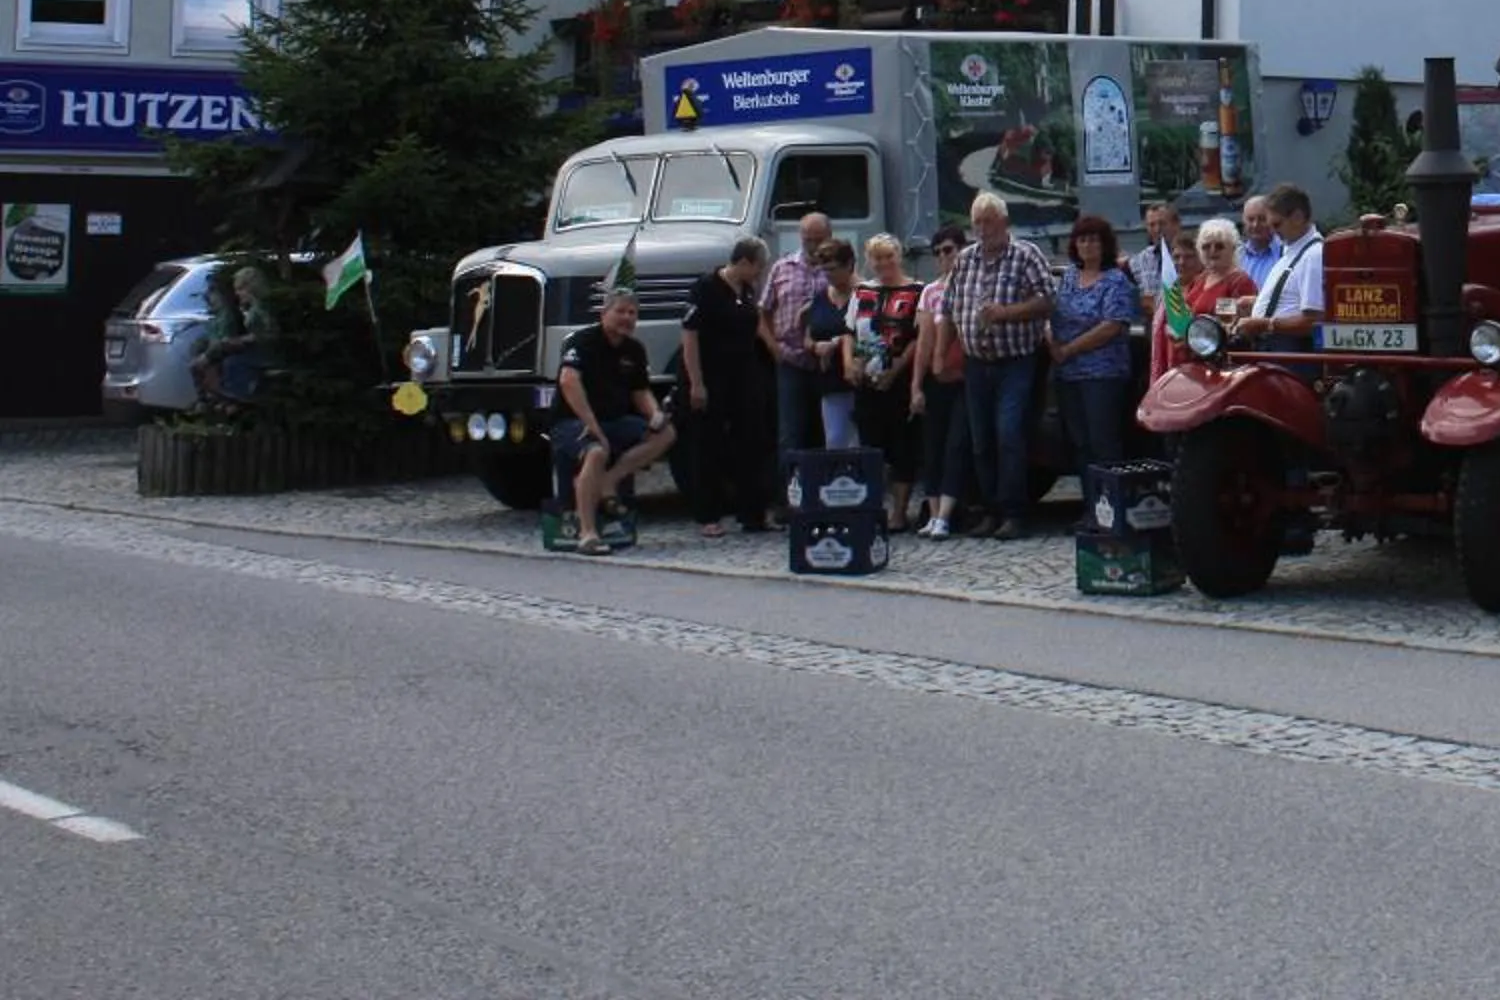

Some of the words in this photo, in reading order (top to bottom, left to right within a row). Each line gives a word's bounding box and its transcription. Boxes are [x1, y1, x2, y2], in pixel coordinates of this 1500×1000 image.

[721, 68, 811, 90] Weltenburger
[59, 89, 278, 132] HUTZEN
[733, 91, 801, 111] Bierkutsche
[1345, 288, 1385, 303] LANZ
[1336, 302, 1398, 318] BULLDOG
[1383, 328, 1405, 348] 23
